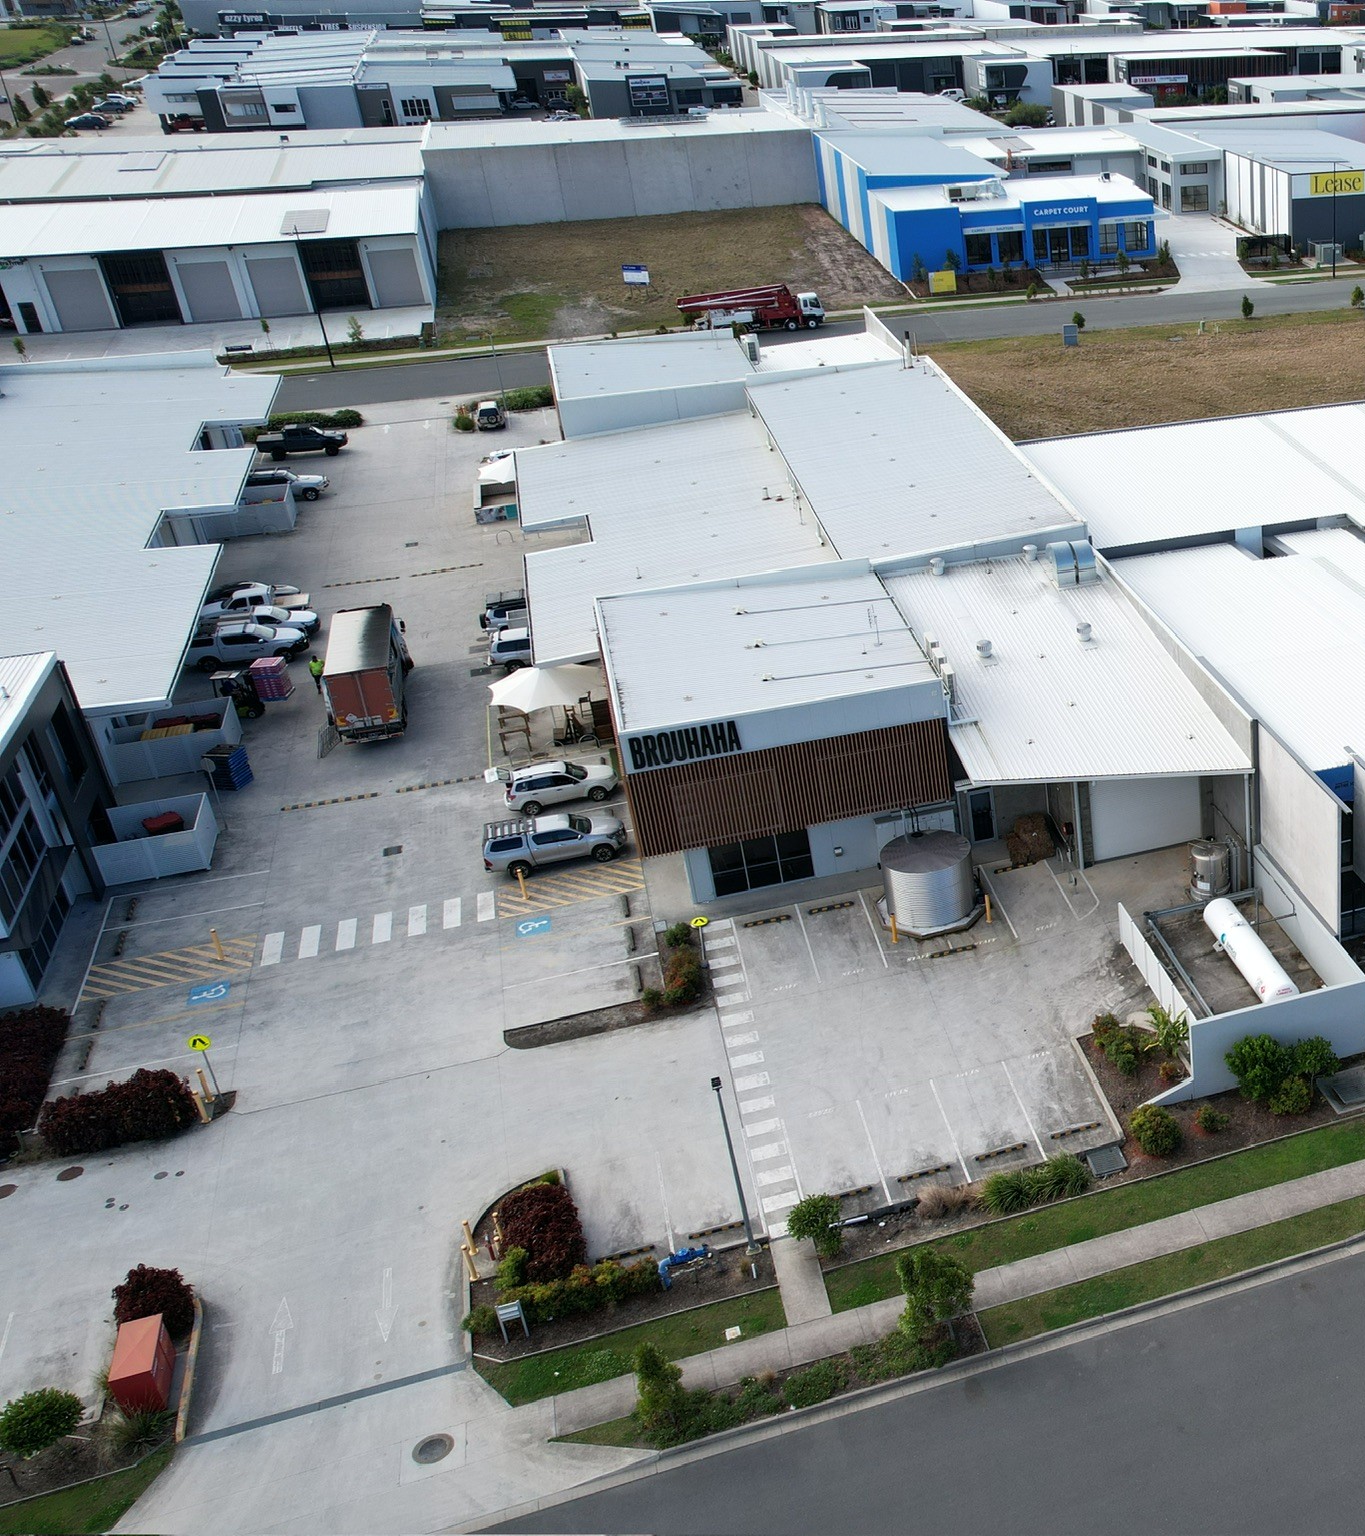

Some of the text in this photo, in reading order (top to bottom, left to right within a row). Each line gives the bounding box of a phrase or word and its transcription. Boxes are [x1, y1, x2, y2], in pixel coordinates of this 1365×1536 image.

[224, 14, 264, 24] ozzy tyres
[320, 23, 340, 31] TYRES
[348, 23, 387, 31] SUSPENSION
[1314, 175, 1361, 193] Lease
[1034, 205, 1089, 217] CARPET COURT
[628, 720, 742, 770] BROUHAHA
